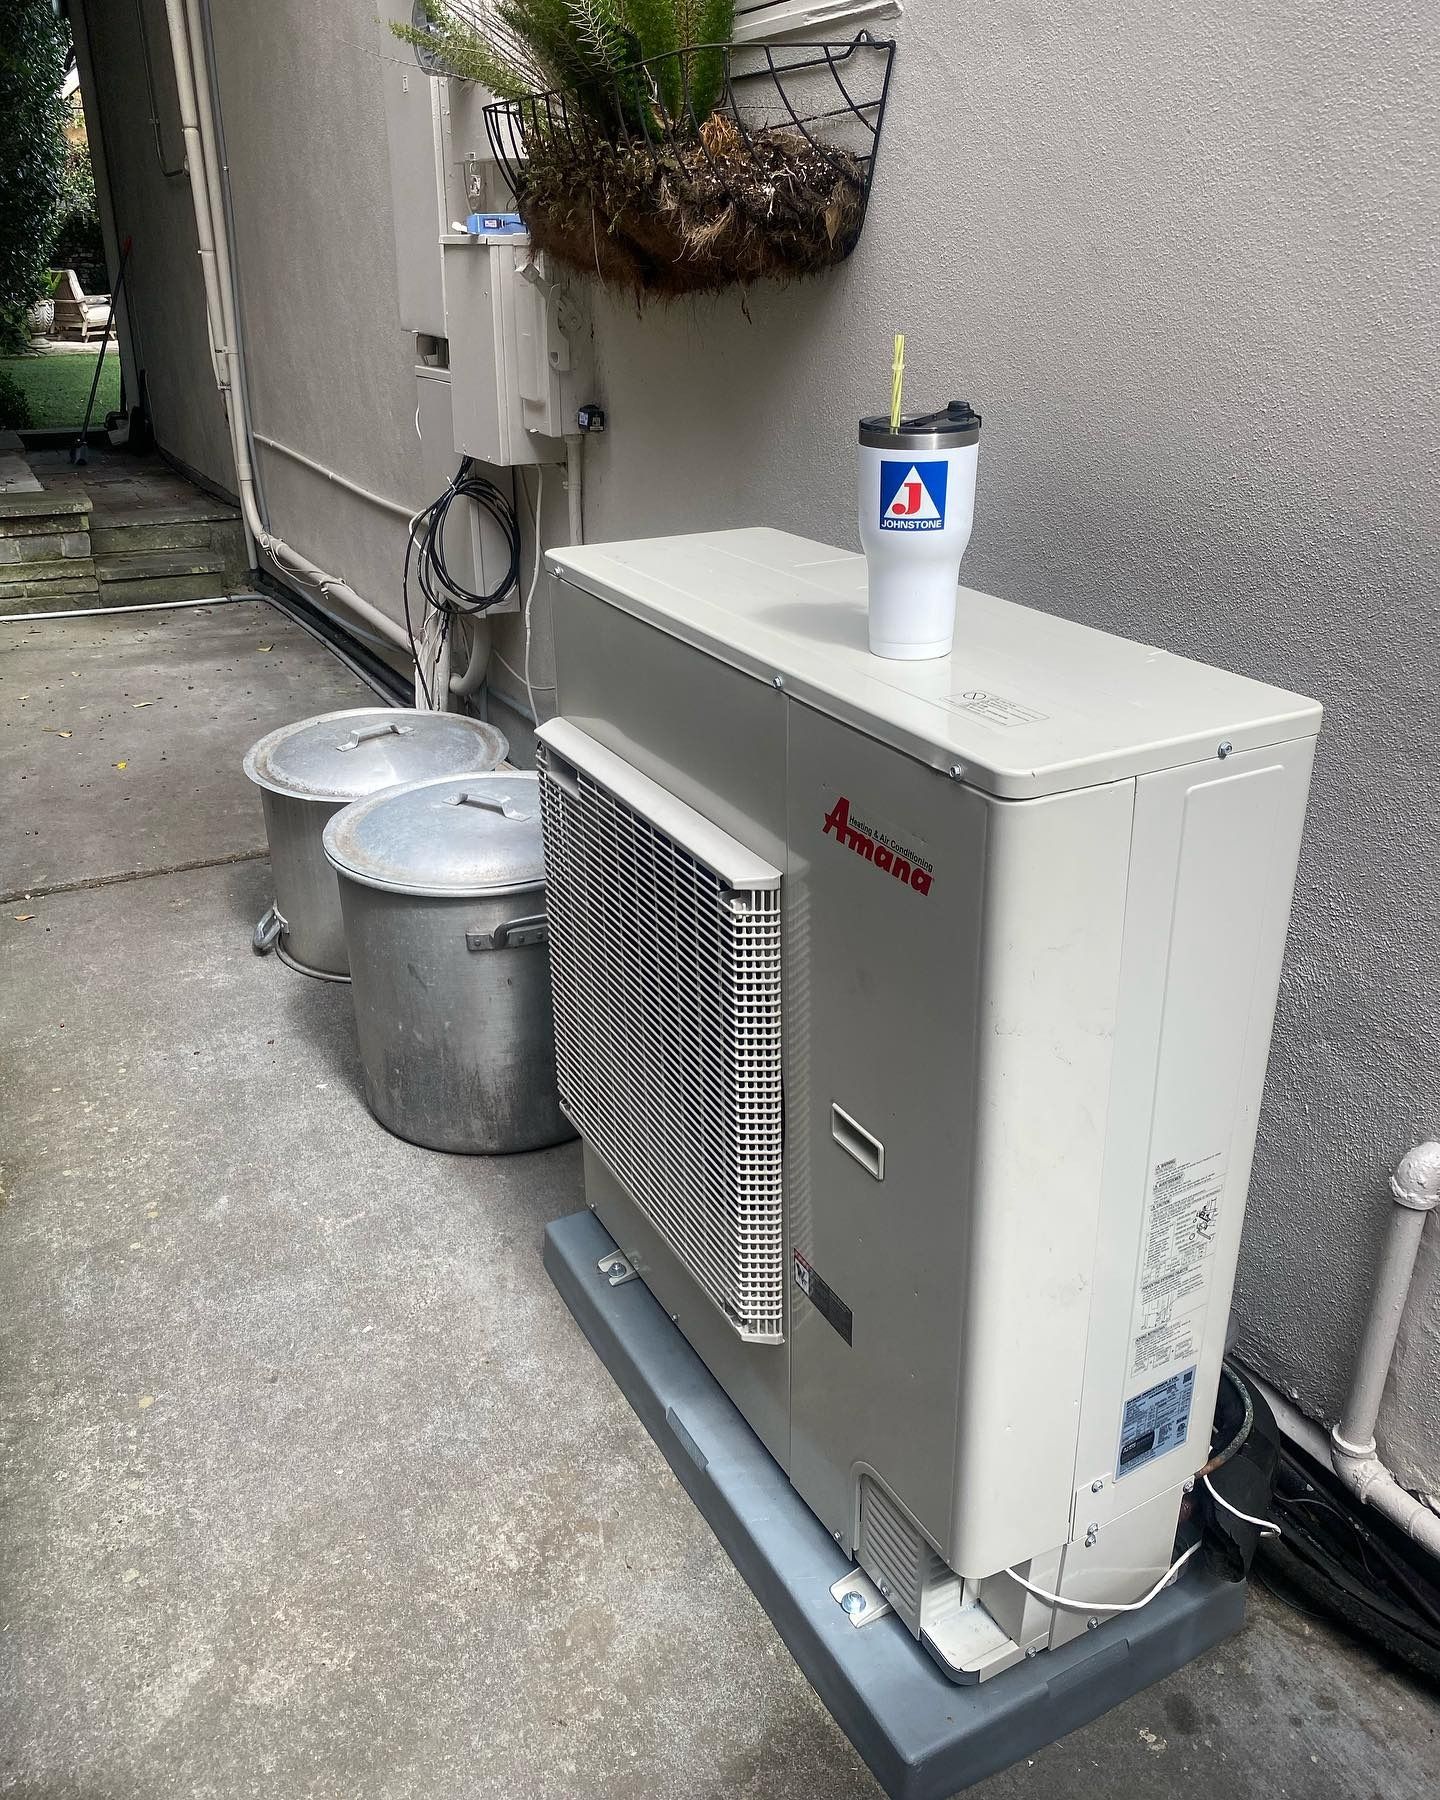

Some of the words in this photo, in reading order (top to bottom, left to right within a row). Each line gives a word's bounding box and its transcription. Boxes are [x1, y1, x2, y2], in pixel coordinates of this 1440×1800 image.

[892, 483, 922, 515] J
[881, 520, 943, 529] JOHNSTONE
[822, 797, 933, 897] Amana
[849, 815, 873, 837] Heating
[873, 830, 879, 840] &
[880, 833, 890, 846] Air
[891, 840, 934, 873] Conditioning
